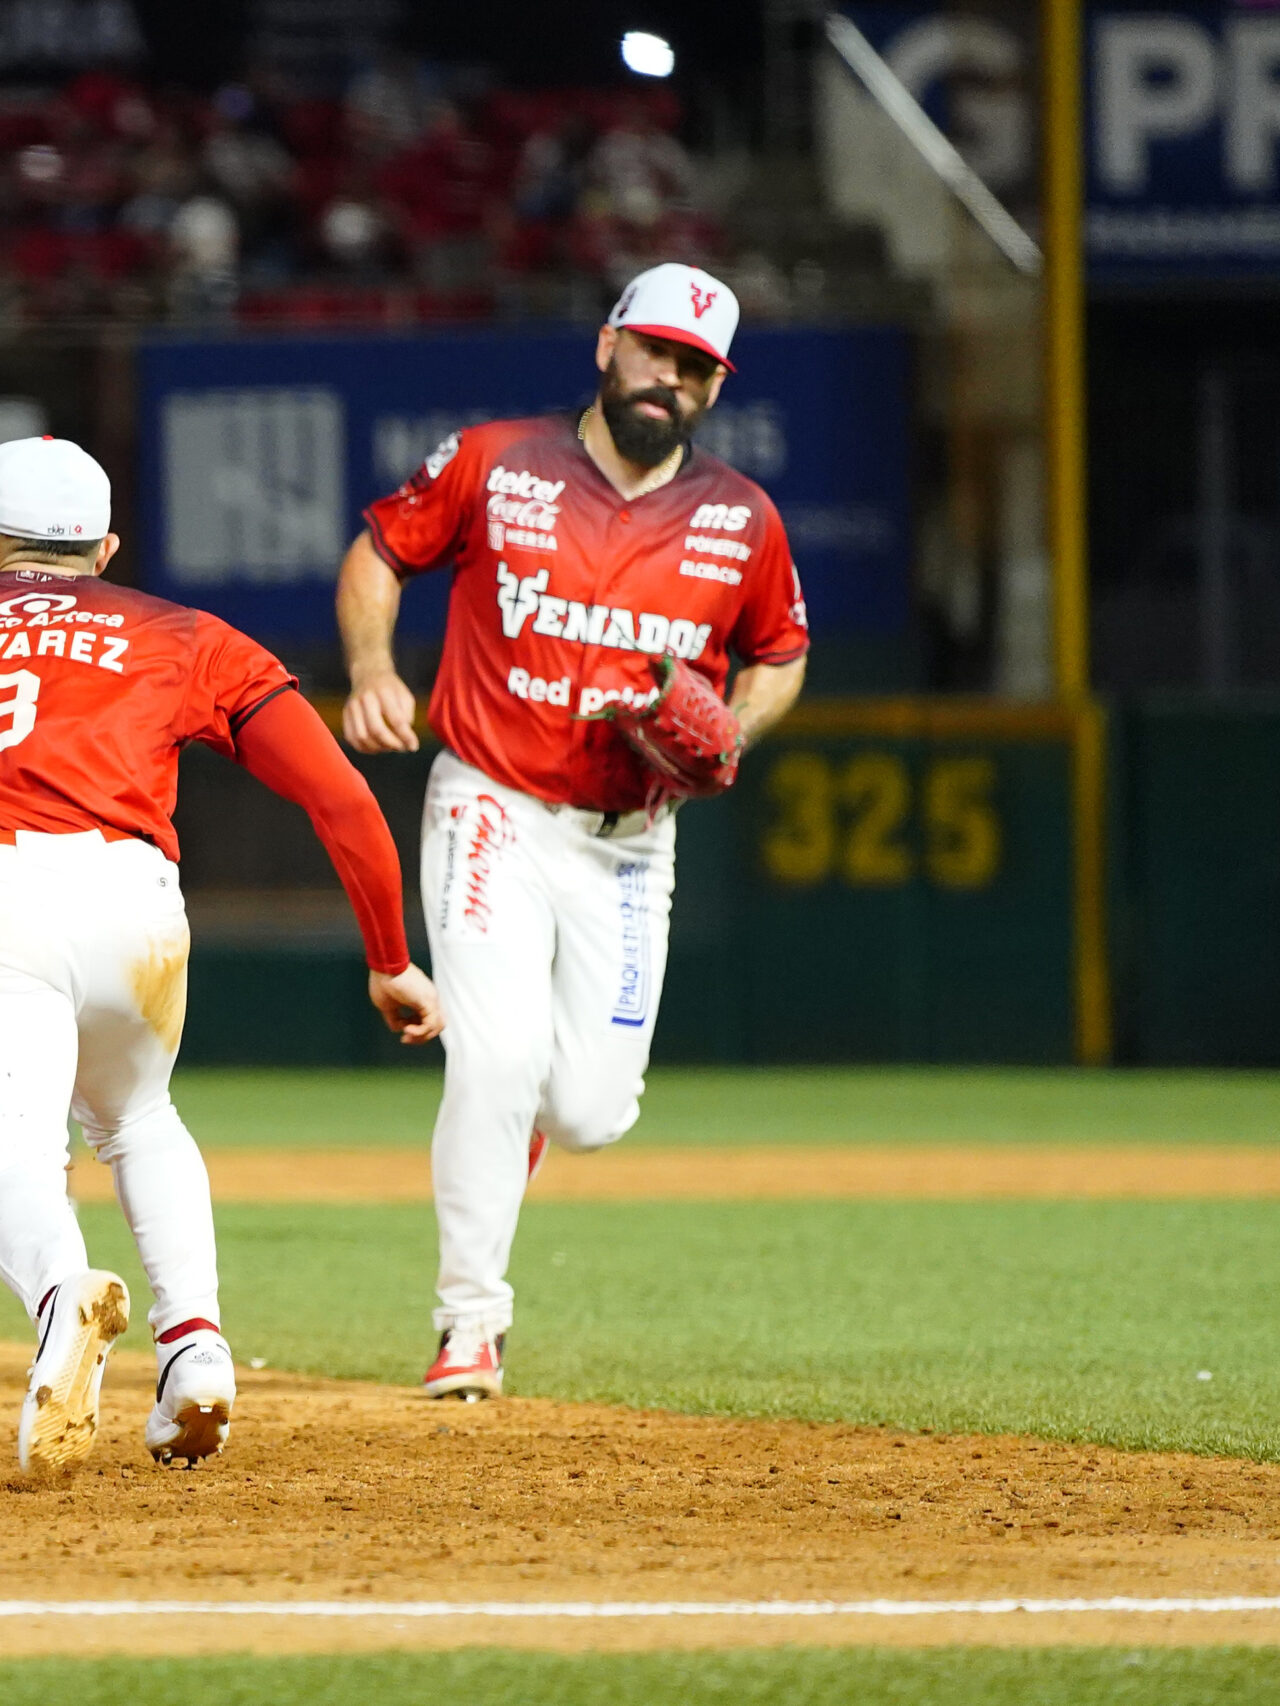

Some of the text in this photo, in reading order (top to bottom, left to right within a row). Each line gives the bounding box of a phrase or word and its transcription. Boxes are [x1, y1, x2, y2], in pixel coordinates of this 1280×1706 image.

[26, 611, 125, 629] Azteca
[497, 561, 712, 660] VENADOS
[507, 665, 572, 707] Red
[767, 752, 1000, 889] 325
